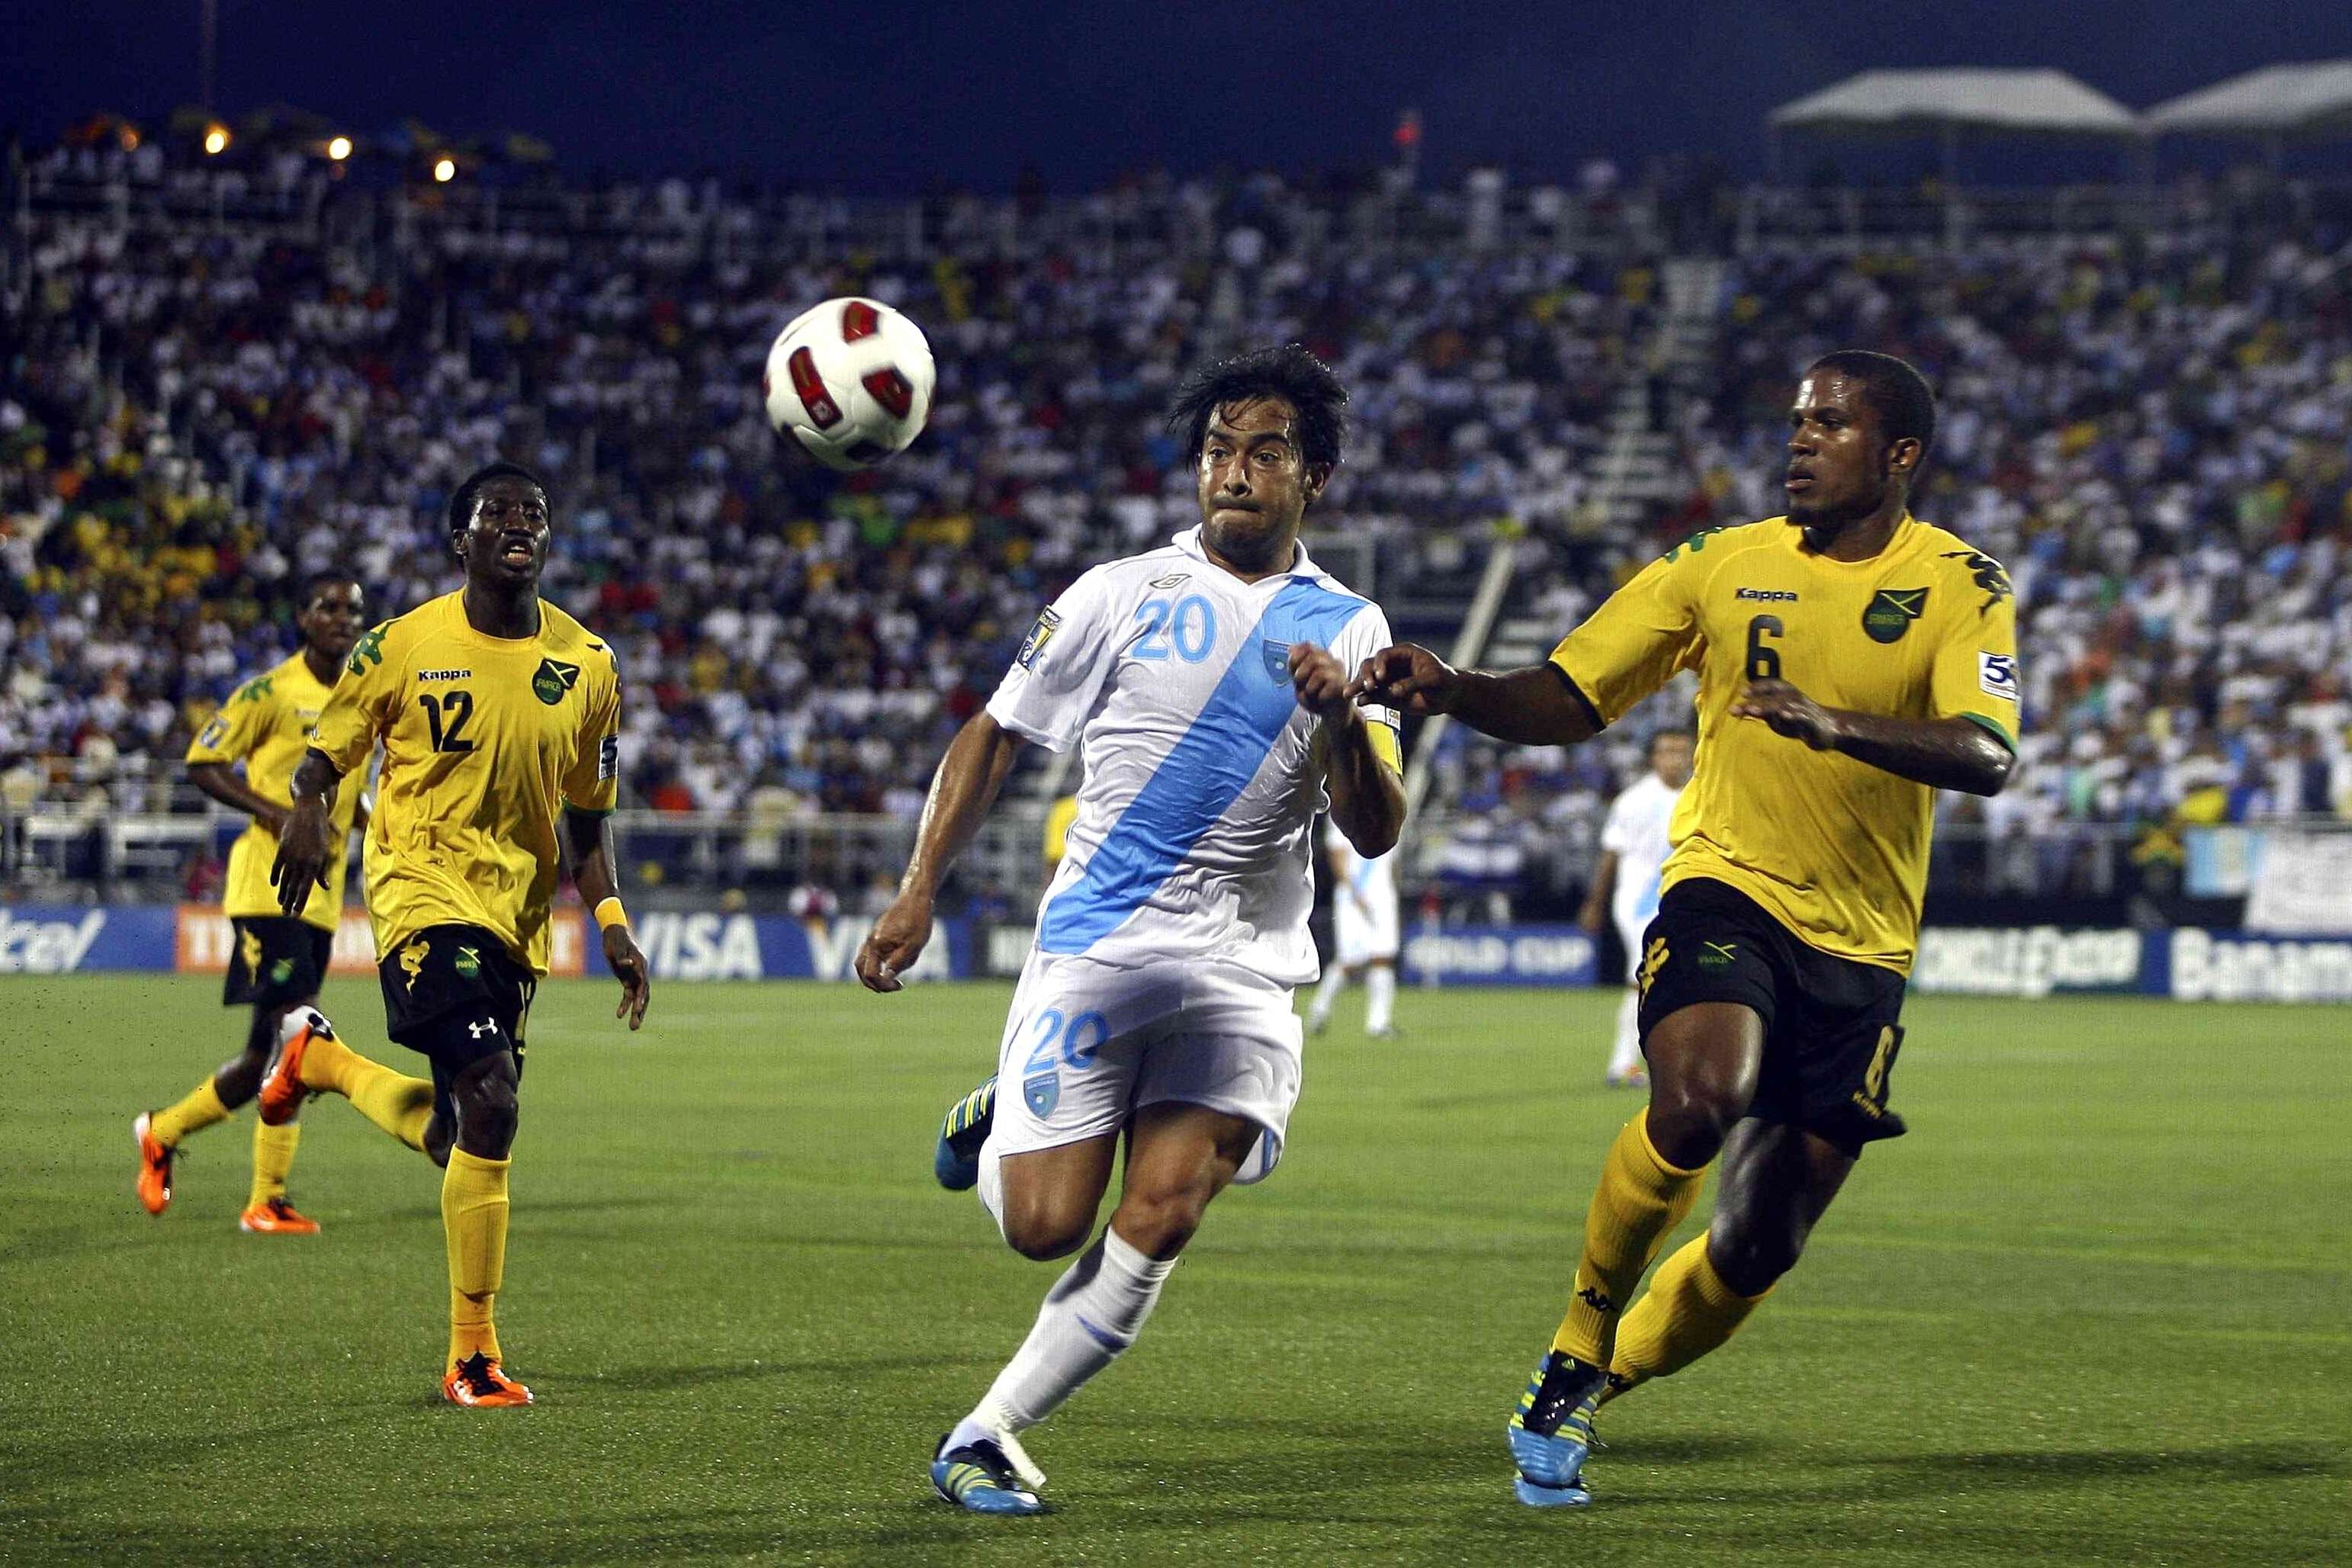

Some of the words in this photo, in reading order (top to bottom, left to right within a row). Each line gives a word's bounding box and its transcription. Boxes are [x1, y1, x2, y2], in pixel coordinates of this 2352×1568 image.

[1130, 593, 1217, 664] 20
[1734, 587, 1798, 602] Kappa
[418, 670, 472, 682] Kappa
[1746, 614, 1783, 683] 6
[419, 690, 474, 753] 12
[636, 912, 762, 982] VISA
[1022, 1007, 1110, 1075] 20
